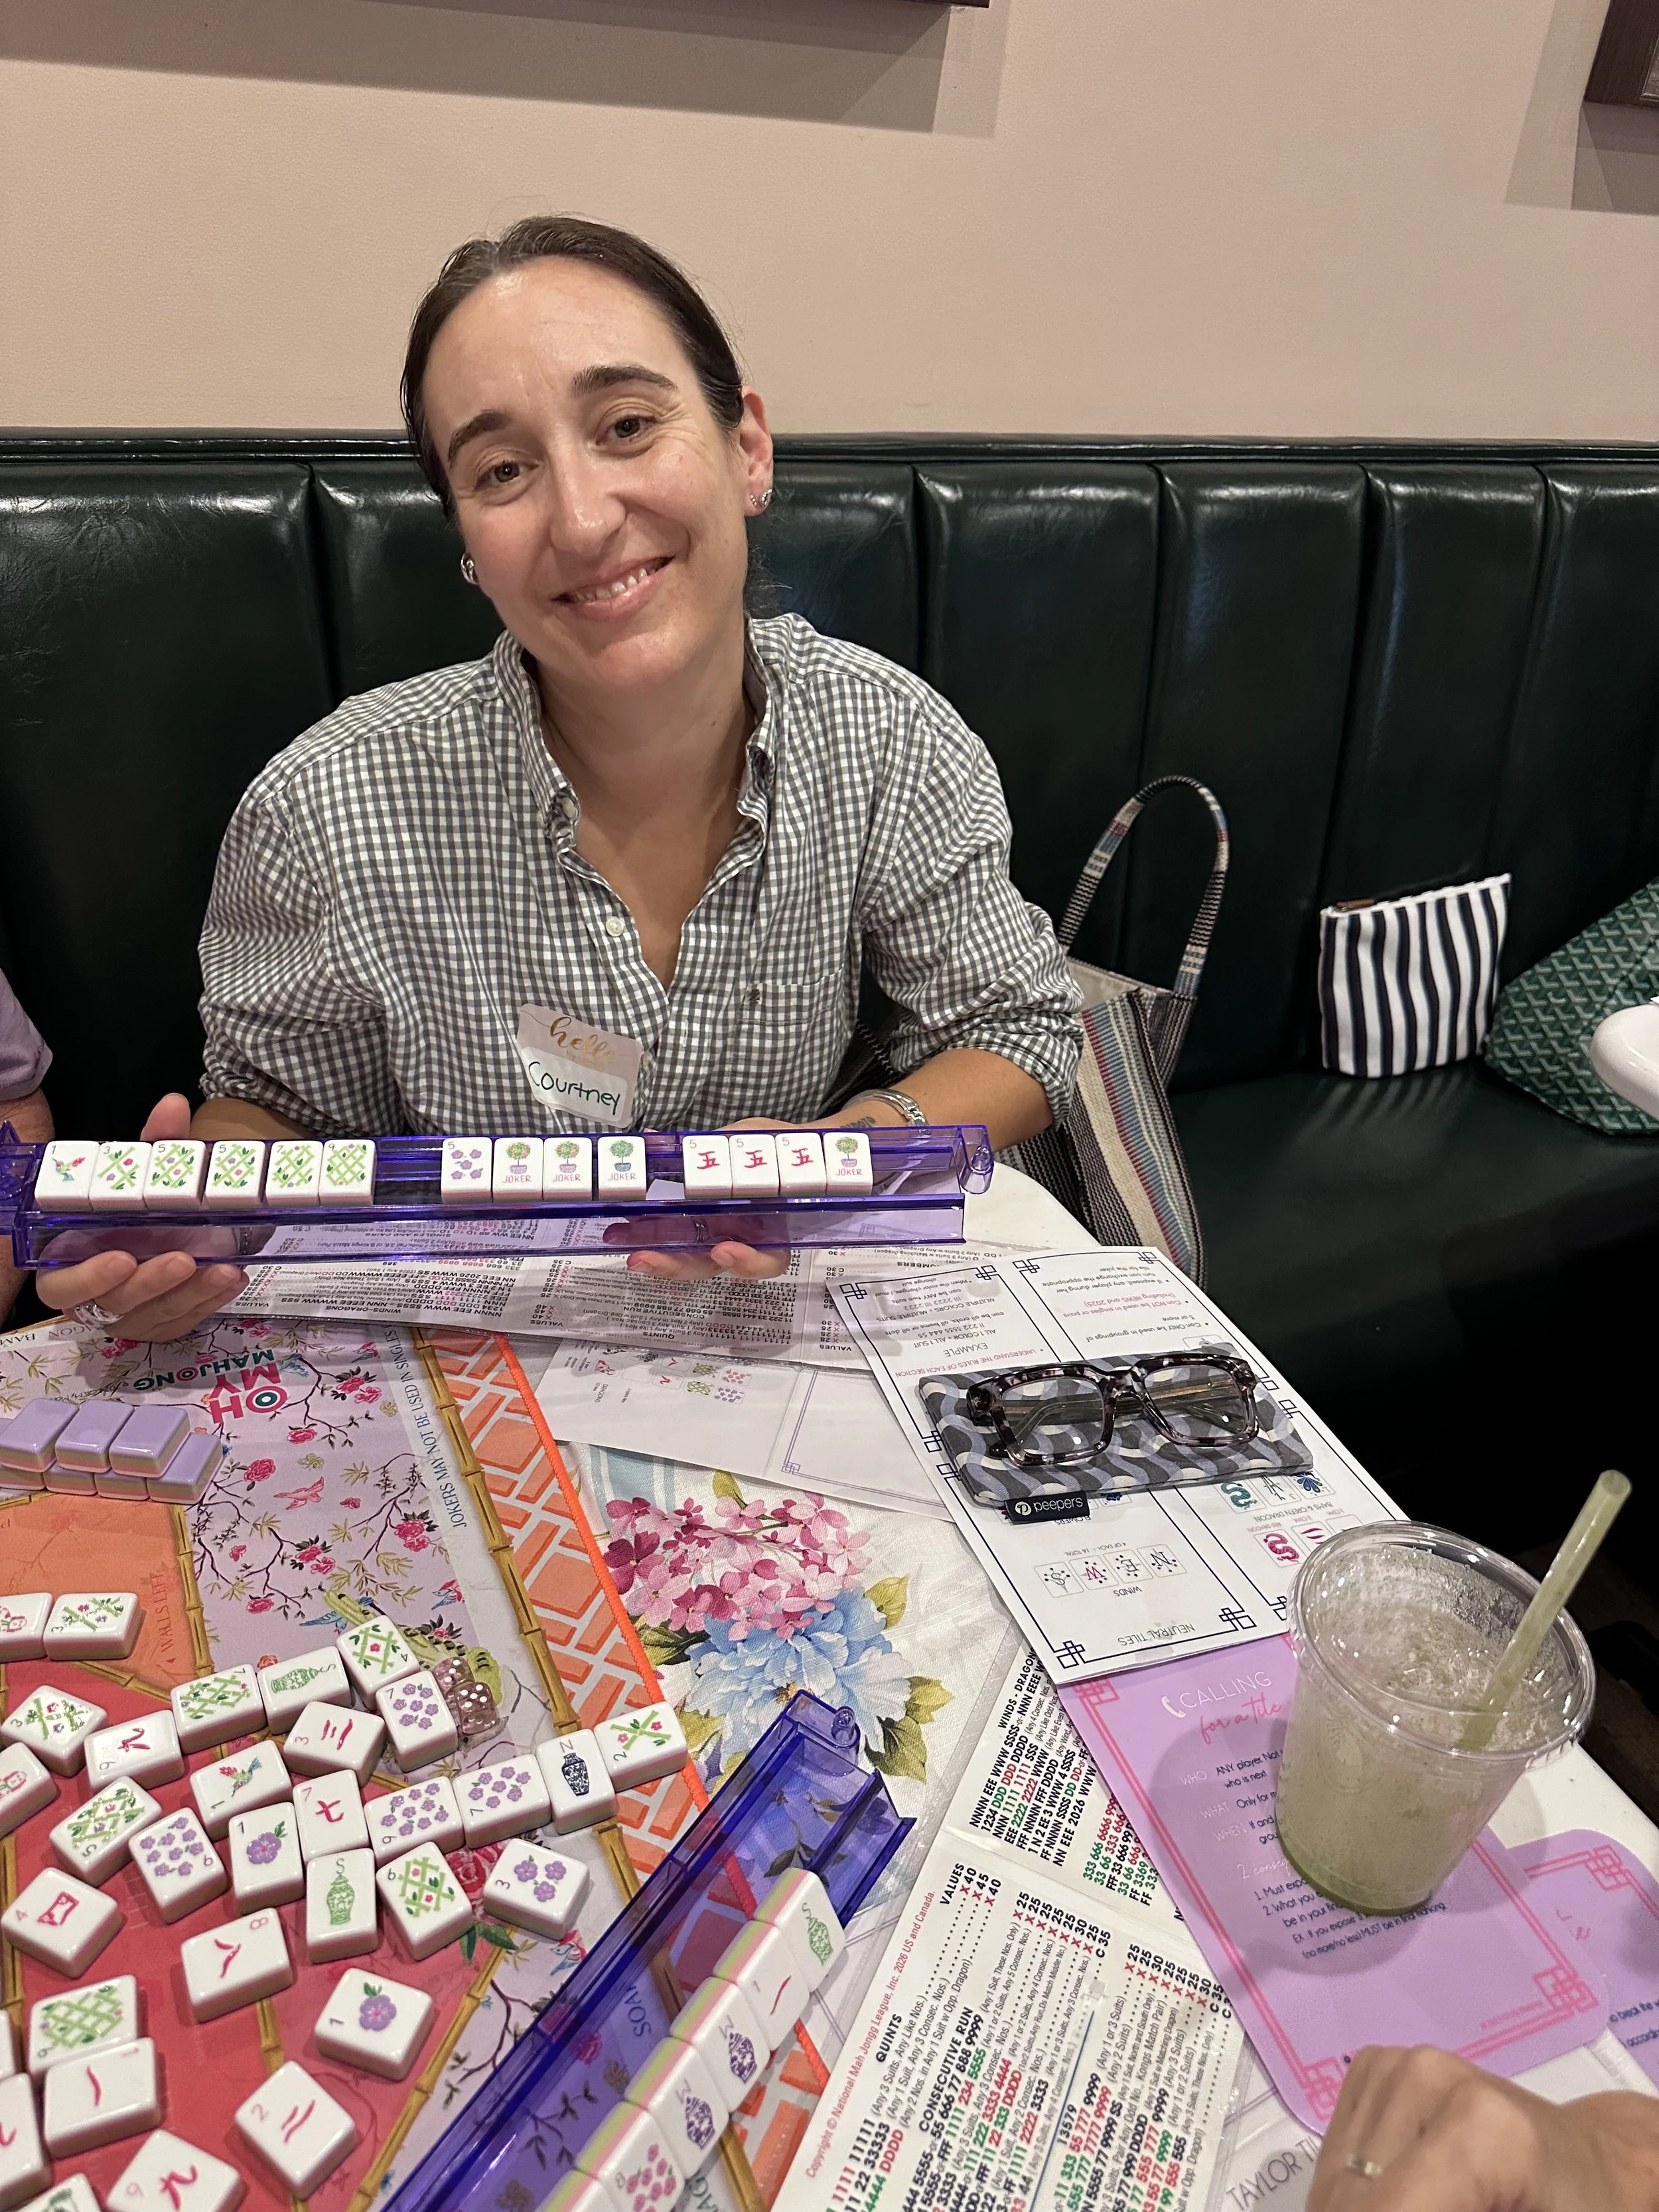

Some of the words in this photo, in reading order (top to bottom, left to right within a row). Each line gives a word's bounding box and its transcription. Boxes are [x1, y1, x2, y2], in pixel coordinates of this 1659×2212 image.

[549, 1016, 614, 1052] hello
[523, 1061, 621, 1116] Courtney
[52, 1145, 57, 1155] 1
[103, 1145, 112, 1156] 3
[157, 1143, 167, 1153] 5
[218, 1143, 227, 1154] 5
[276, 1144, 285, 1155] 7
[328, 1143, 336, 1153] 9
[447, 1141, 456, 1150] 5
[689, 1139, 697, 1149] 5
[737, 1138, 745, 1148] 5
[782, 1136, 790, 1147] 5
[502, 1174, 532, 1184] JOKER
[552, 1173, 582, 1183] JOKER
[608, 1173, 637, 1181] JOKER
[835, 1167, 863, 1177] JOKER
[635, 1305, 706, 1319] CONSECUTIVE
[642, 1331, 676, 1340] QUINTS
[383, 1329, 411, 1372] SINGLES
[943, 1342, 989, 1358] EXAMPLE
[993, 1349, 1037, 1361] UNDERSTAND
[133, 1349, 276, 1391] MAHJONG
[895, 1368, 926, 1378] SECTION
[925, 1365, 946, 1374] EACH
[957, 1359, 979, 1368] RULES
[204, 1361, 281, 1400] MY
[399, 1371, 414, 1383] IN
[208, 1385, 291, 1424] OH
[403, 1384, 424, 1412] USED
[413, 1412, 431, 1429] BE
[419, 1431, 441, 1455] NOT
[431, 1457, 450, 1481] MAY
[439, 1482, 468, 1528] JOKERS
[1033, 1497, 1084, 1513] peepers
[1119, 1558, 1140, 1573] E
[1149, 1551, 1173, 1568] N
[1050, 1570, 1066, 1586] S
[1085, 1566, 1106, 1581] W
[149, 1572, 170, 1604] LEFT
[1112, 1585, 1143, 1597] WINDS
[153, 1605, 175, 1653] WALLS
[1146, 1623, 1196, 1639] NEUTRAL
[1117, 1633, 1149, 1647] TILES
[386, 1687, 395, 1700] 7
[1179, 1671, 1272, 1708] CALLING
[997, 1698, 1017, 1729] WINDS
[1198, 1713, 1232, 1745] for
[1232, 1710, 1250, 1725] a
[1241, 1691, 1286, 1728] tile
[613, 1751, 628, 1762] 2
[989, 1747, 1010, 1777] WWW
[1078, 1765, 1101, 1797] WWW
[1179, 1770, 1208, 1785] WHO
[1216, 1762, 1235, 1776] ANY
[1224, 1778, 1242, 1789] who
[1250, 1769, 1267, 1781] next
[980, 1808, 999, 1832] 1234
[990, 1786, 1007, 1809] DDD
[1000, 1763, 1017, 1787] DDD
[1009, 1735, 1029, 1764] DDDD
[982, 1777, 998, 1797] EEE
[302, 1786, 313, 1803] 7
[968, 1795, 990, 1828] NNNN
[1067, 1799, 1086, 1827] 2026
[1198, 1801, 1230, 1820] WHAT
[1236, 1796, 1257, 1809] Only
[1256, 1793, 1269, 1803] for
[238, 1820, 245, 1834] 1
[1096, 1816, 1113, 1842] 6666
[1214, 1822, 1248, 1842] WHEN
[1059, 1827, 1075, 1848] EEE
[81, 1844, 98, 1858] 5
[1052, 1848, 1068, 1868] NN
[1090, 1841, 1104, 1861] 666
[335, 1857, 346, 1876] S
[964, 1867, 977, 1885] 40
[1082, 1860, 1097, 1881] 333
[494, 1879, 511, 1890] 3
[939, 1863, 965, 1905] VALUES
[959, 1883, 971, 1895] X
[801, 1901, 813, 1921] S
[249, 1916, 269, 1931] 8
[908, 1994, 928, 2020] Nos.)
[875, 2013, 902, 2063] QUINTS
[901, 2019, 916, 2039] Like
[805, 2129, 833, 2179] Copyright
[830, 2075, 856, 2118] National
[848, 2055, 865, 2077] Mah
[859, 2026, 880, 2055] Jongg
[870, 1992, 894, 2026] League,
[885, 1975, 901, 1991] Inc.
[893, 1952, 908, 1974] 2026
[901, 1939, 914, 1953] US
[909, 1921, 922, 1940] and
[894, 2037, 910, 2059] Any
[882, 2059, 902, 2085] Suits,
[918, 2036, 962, 2132] CONSECUTIVE
[955, 2006, 974, 2035] RUN
[879, 2083, 890, 2093] 3
[250, 2103, 269, 2122] 2
[870, 2091, 888, 2117] (Any
[1056, 2104, 1077, 2145] 13579
[1226, 2146, 1303, 2212] TAYLOR
